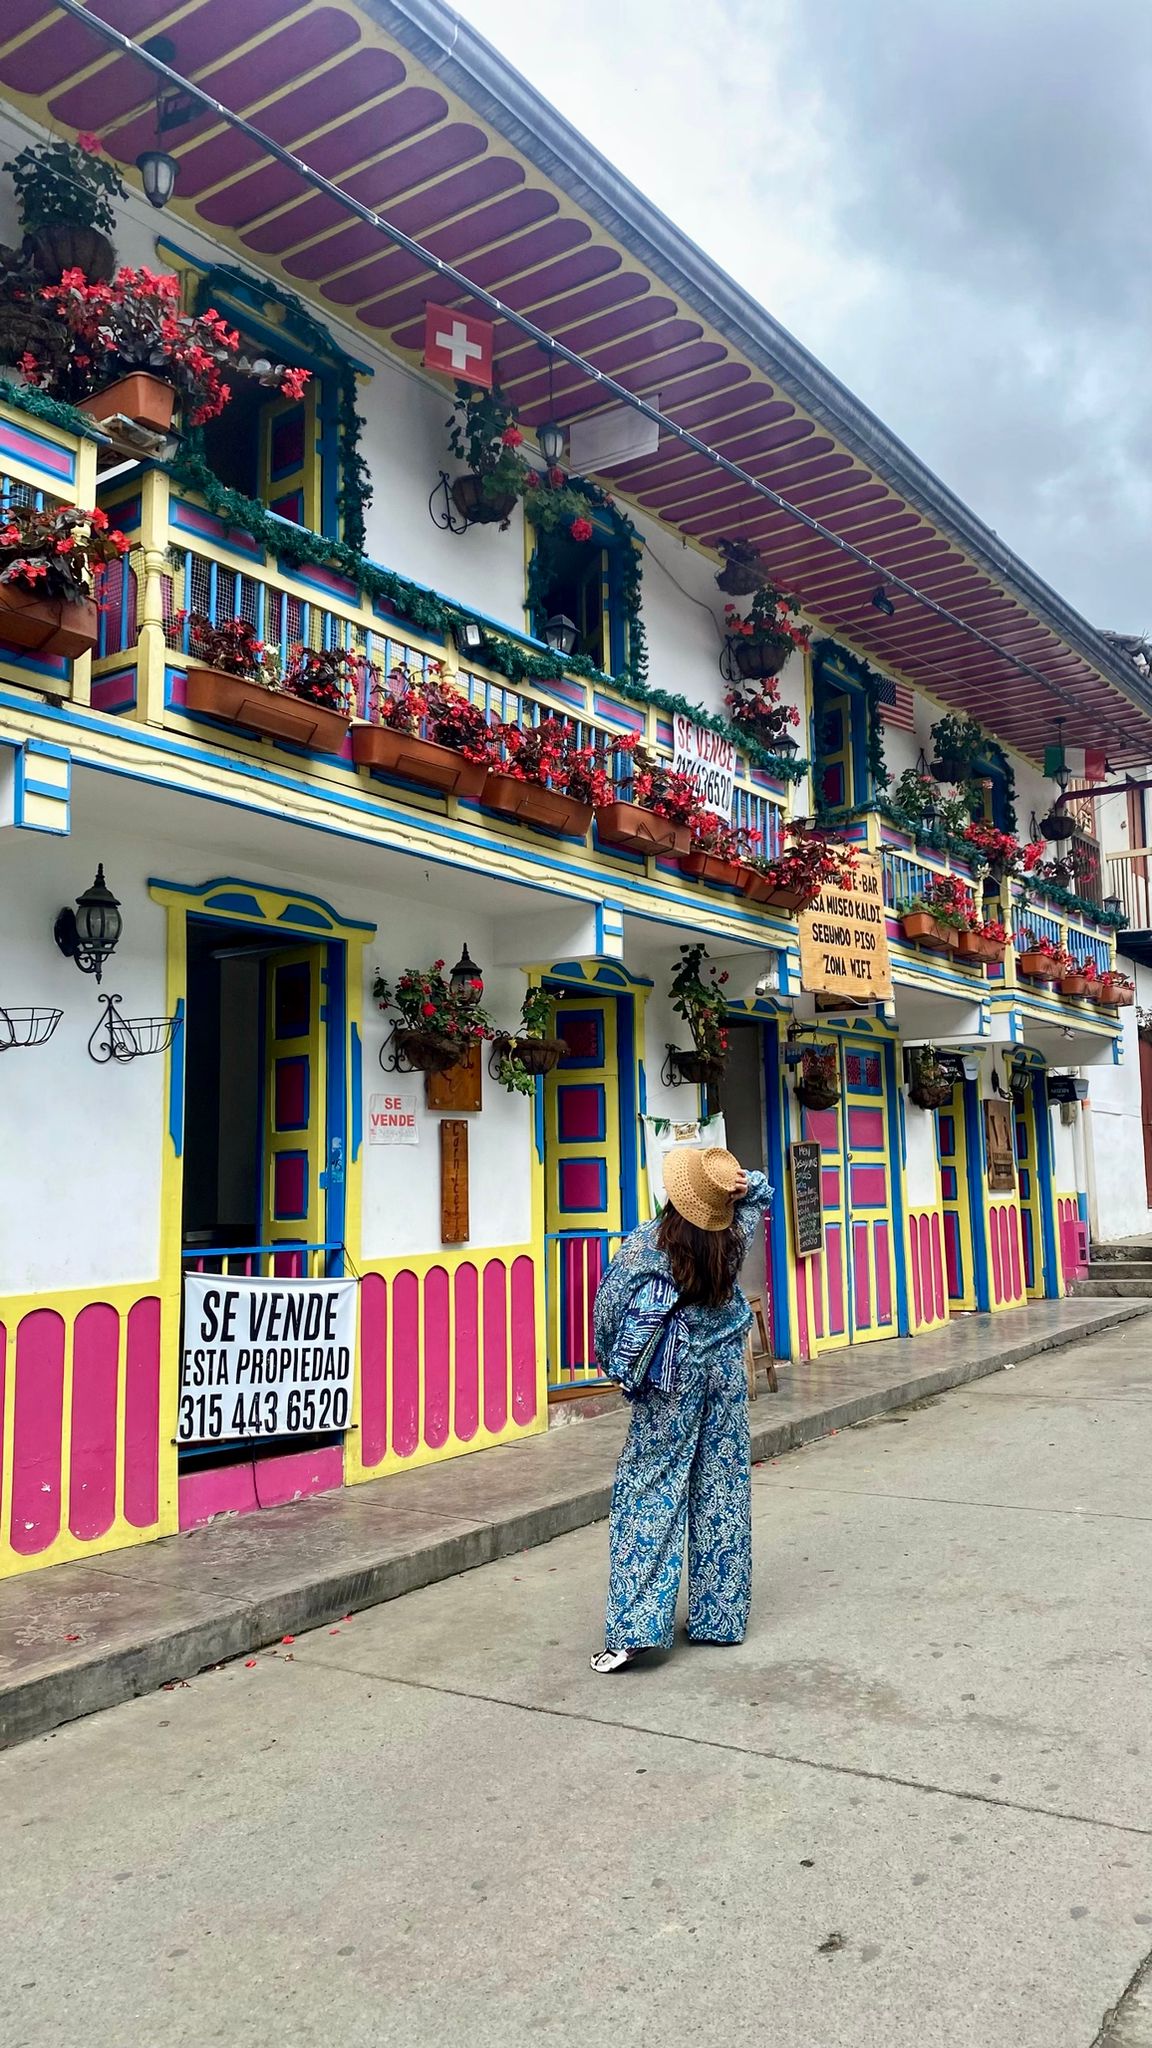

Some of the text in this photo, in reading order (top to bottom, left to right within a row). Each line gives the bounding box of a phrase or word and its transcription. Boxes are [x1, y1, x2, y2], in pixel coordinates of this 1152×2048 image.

[677, 718, 733, 771] SE VENDE
[826, 895, 854, 918] MUSEO
[855, 901, 882, 924] KALDI
[812, 922, 876, 951] SEGUNDO PISO
[823, 954, 872, 980] ZONA WIFI
[384, 1097, 402, 1110] SE
[371, 1114, 415, 1126] VENDE
[200, 1290, 339, 1342] SE VENDE
[182, 1347, 350, 1386] ESTA PROPIEDAD
[179, 1387, 349, 1440] 315 443 6520
